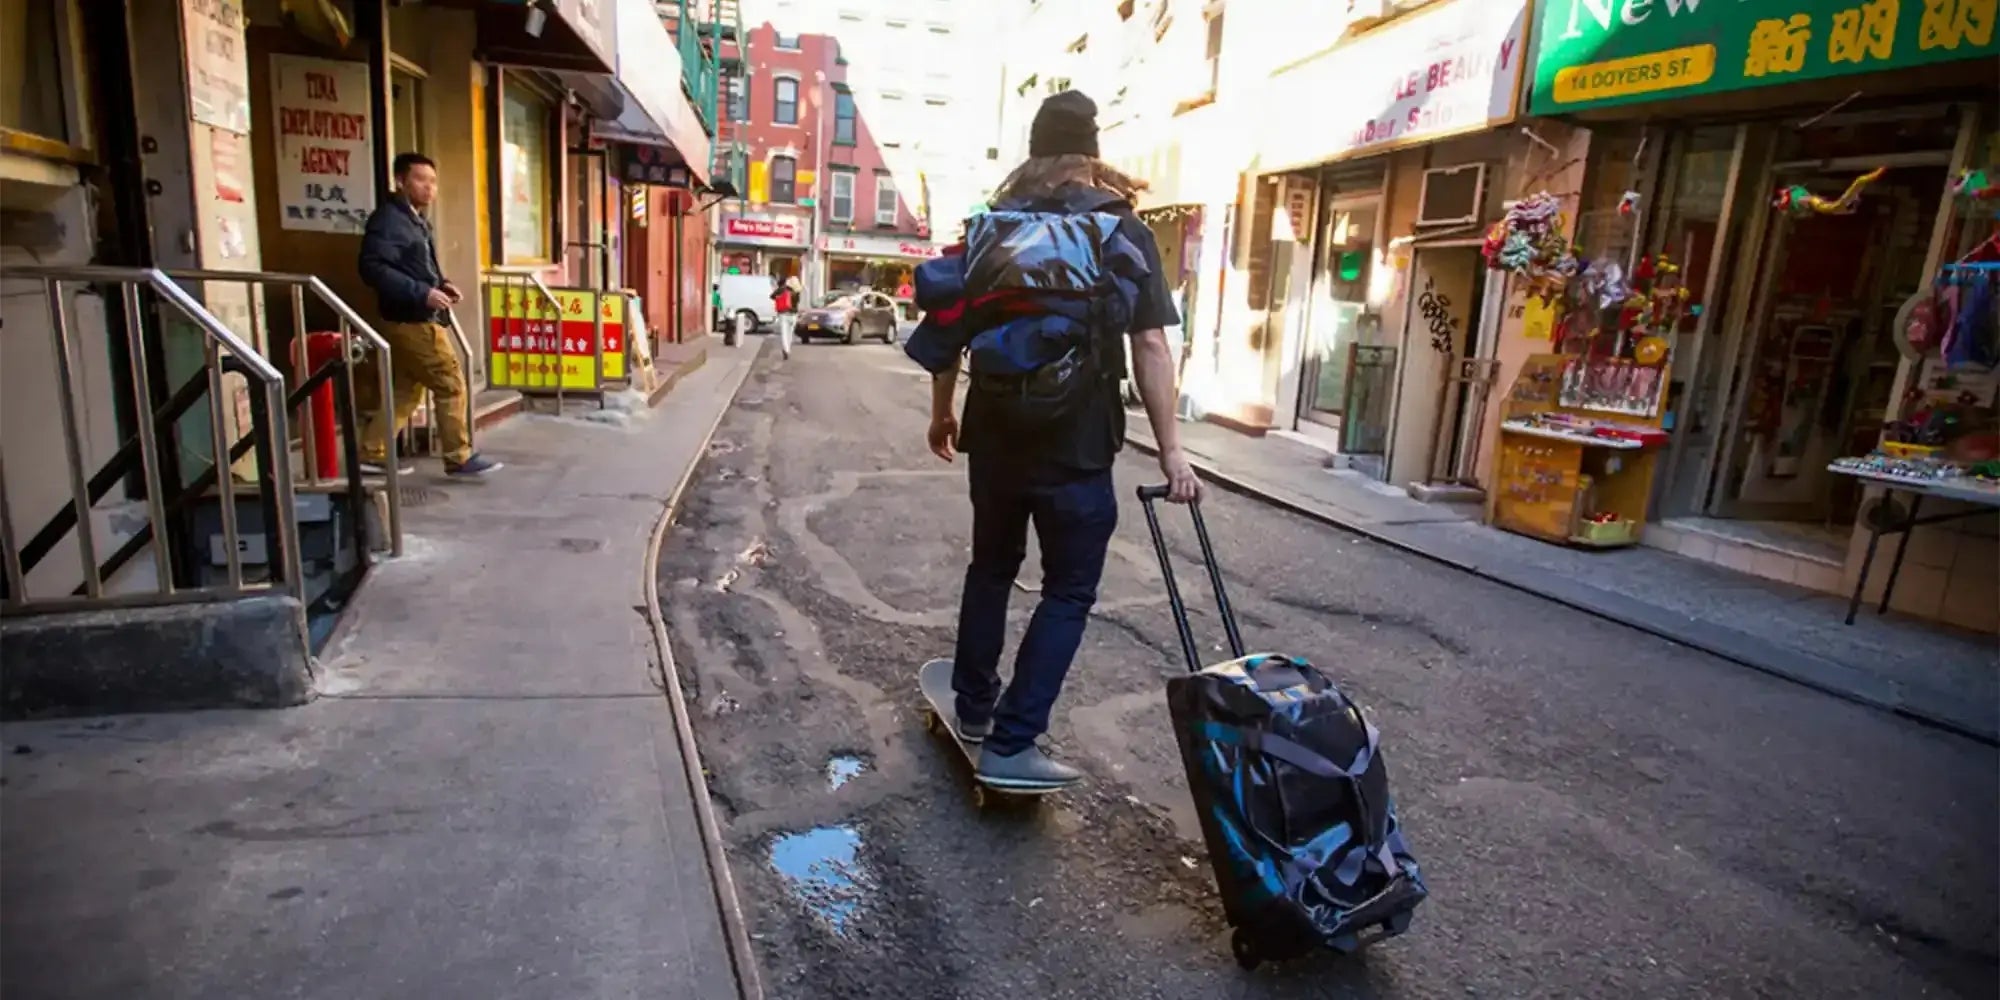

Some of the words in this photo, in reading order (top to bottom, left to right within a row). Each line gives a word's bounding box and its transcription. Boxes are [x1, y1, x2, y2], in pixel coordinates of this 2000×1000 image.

[304, 72, 338, 103] TINA
[1591, 61, 1663, 89] DOYERS
[279, 106, 366, 142] EMPLOYMENT
[300, 146, 351, 177] AGENCY
